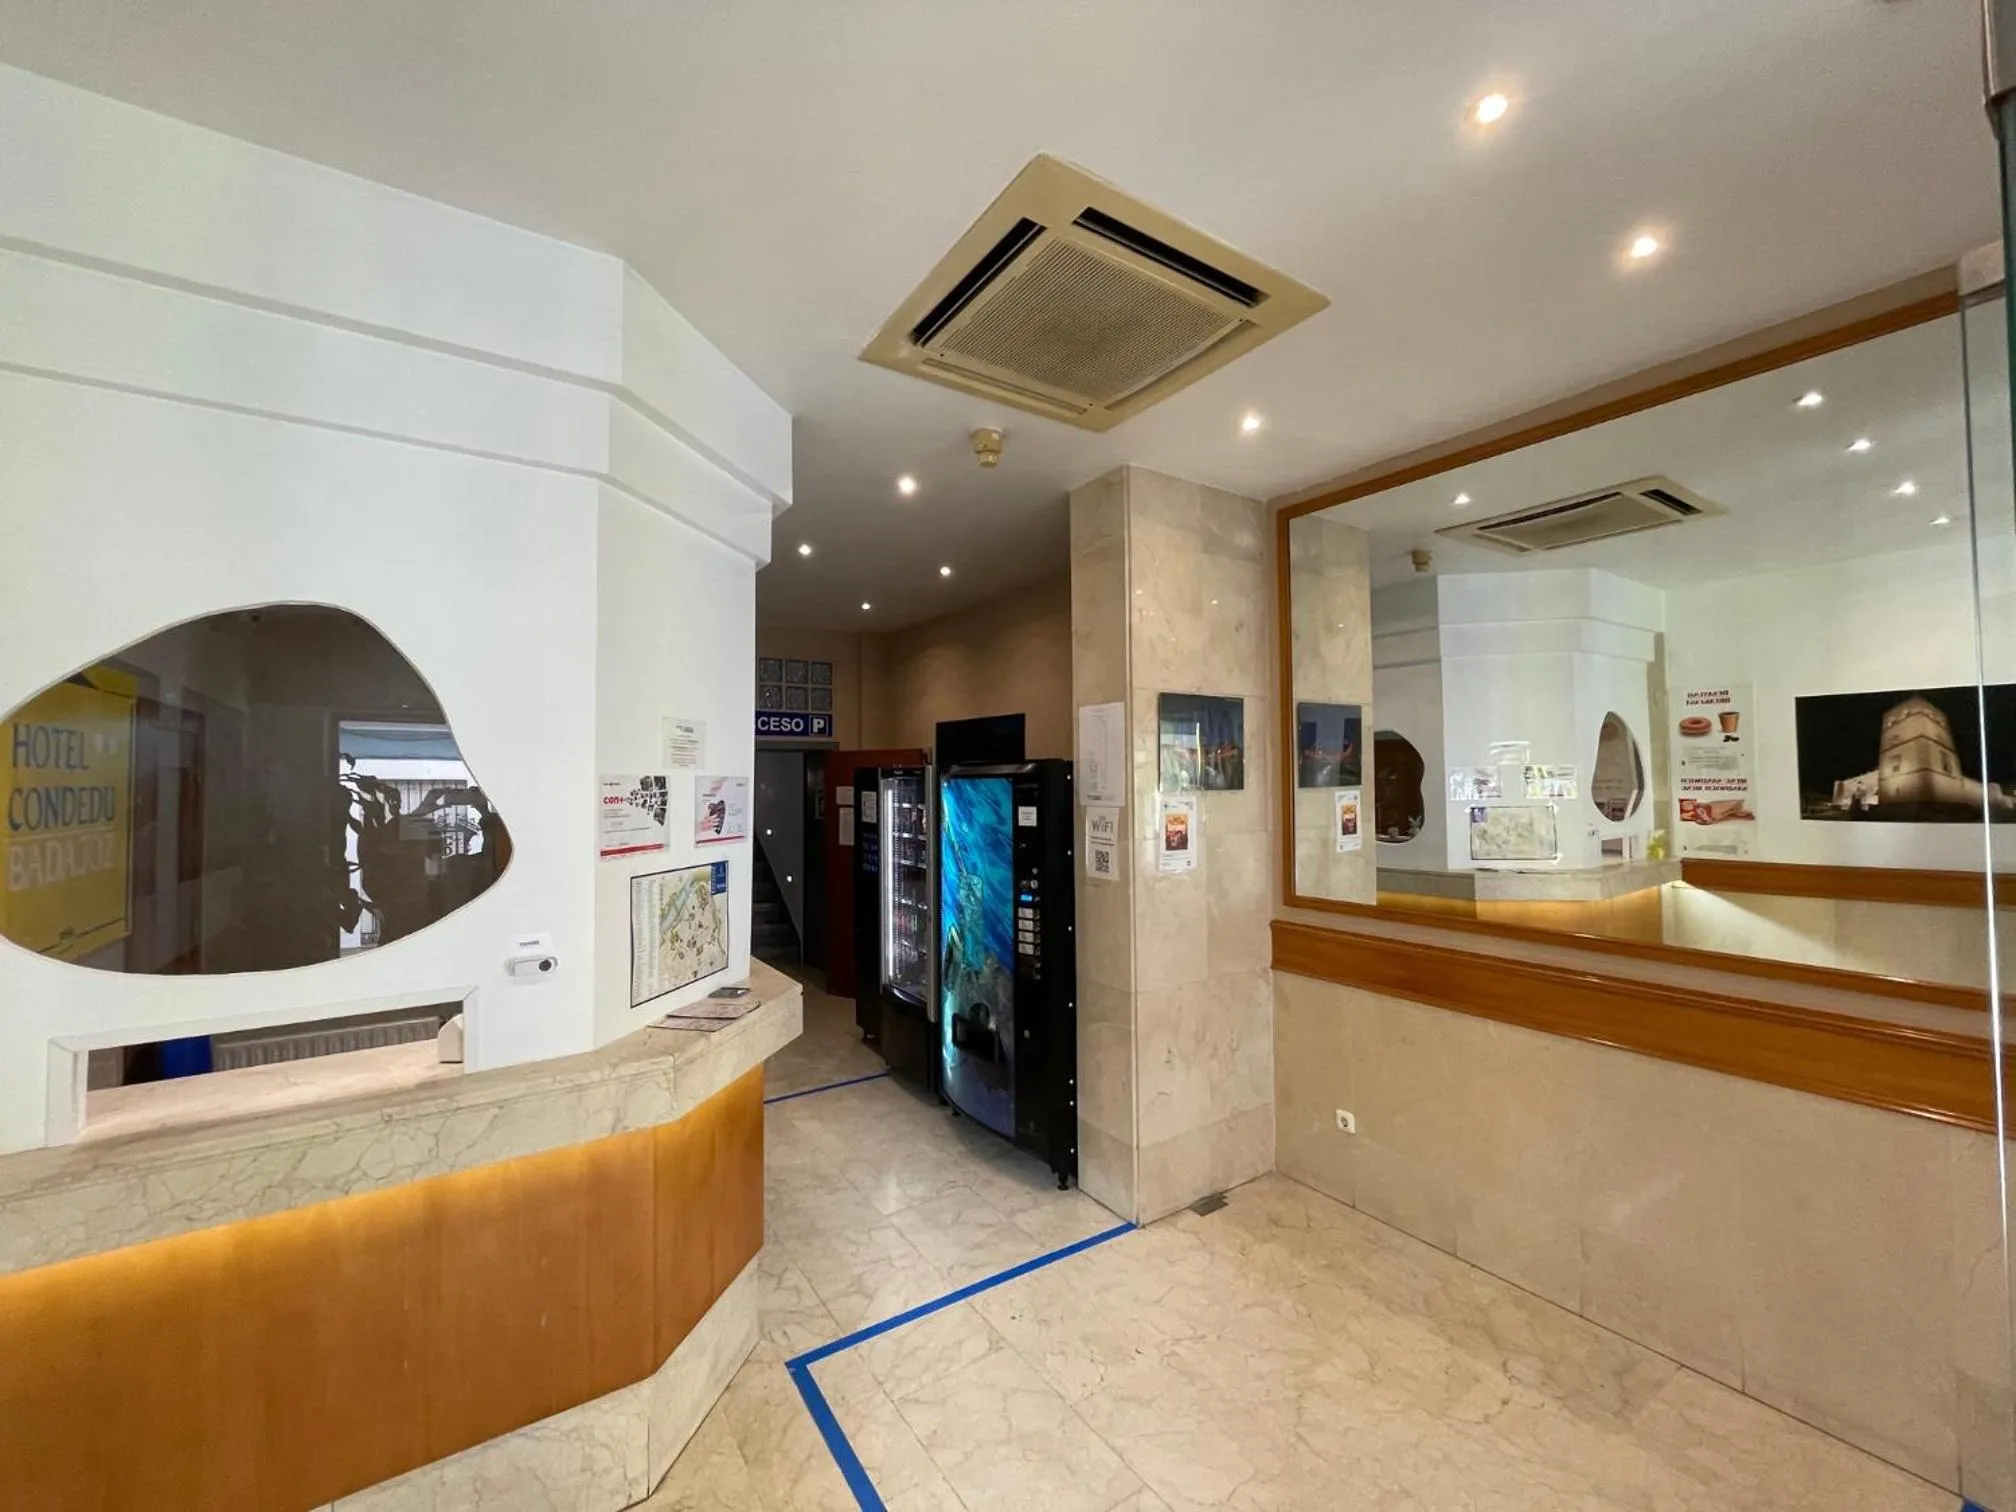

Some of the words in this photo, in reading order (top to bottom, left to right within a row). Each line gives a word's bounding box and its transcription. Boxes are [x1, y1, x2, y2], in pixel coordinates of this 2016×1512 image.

[12, 723, 90, 770] HOTEL
[757, 716, 804, 732] CESO
[812, 718, 825, 734] P
[8, 786, 117, 832] CONDEDU
